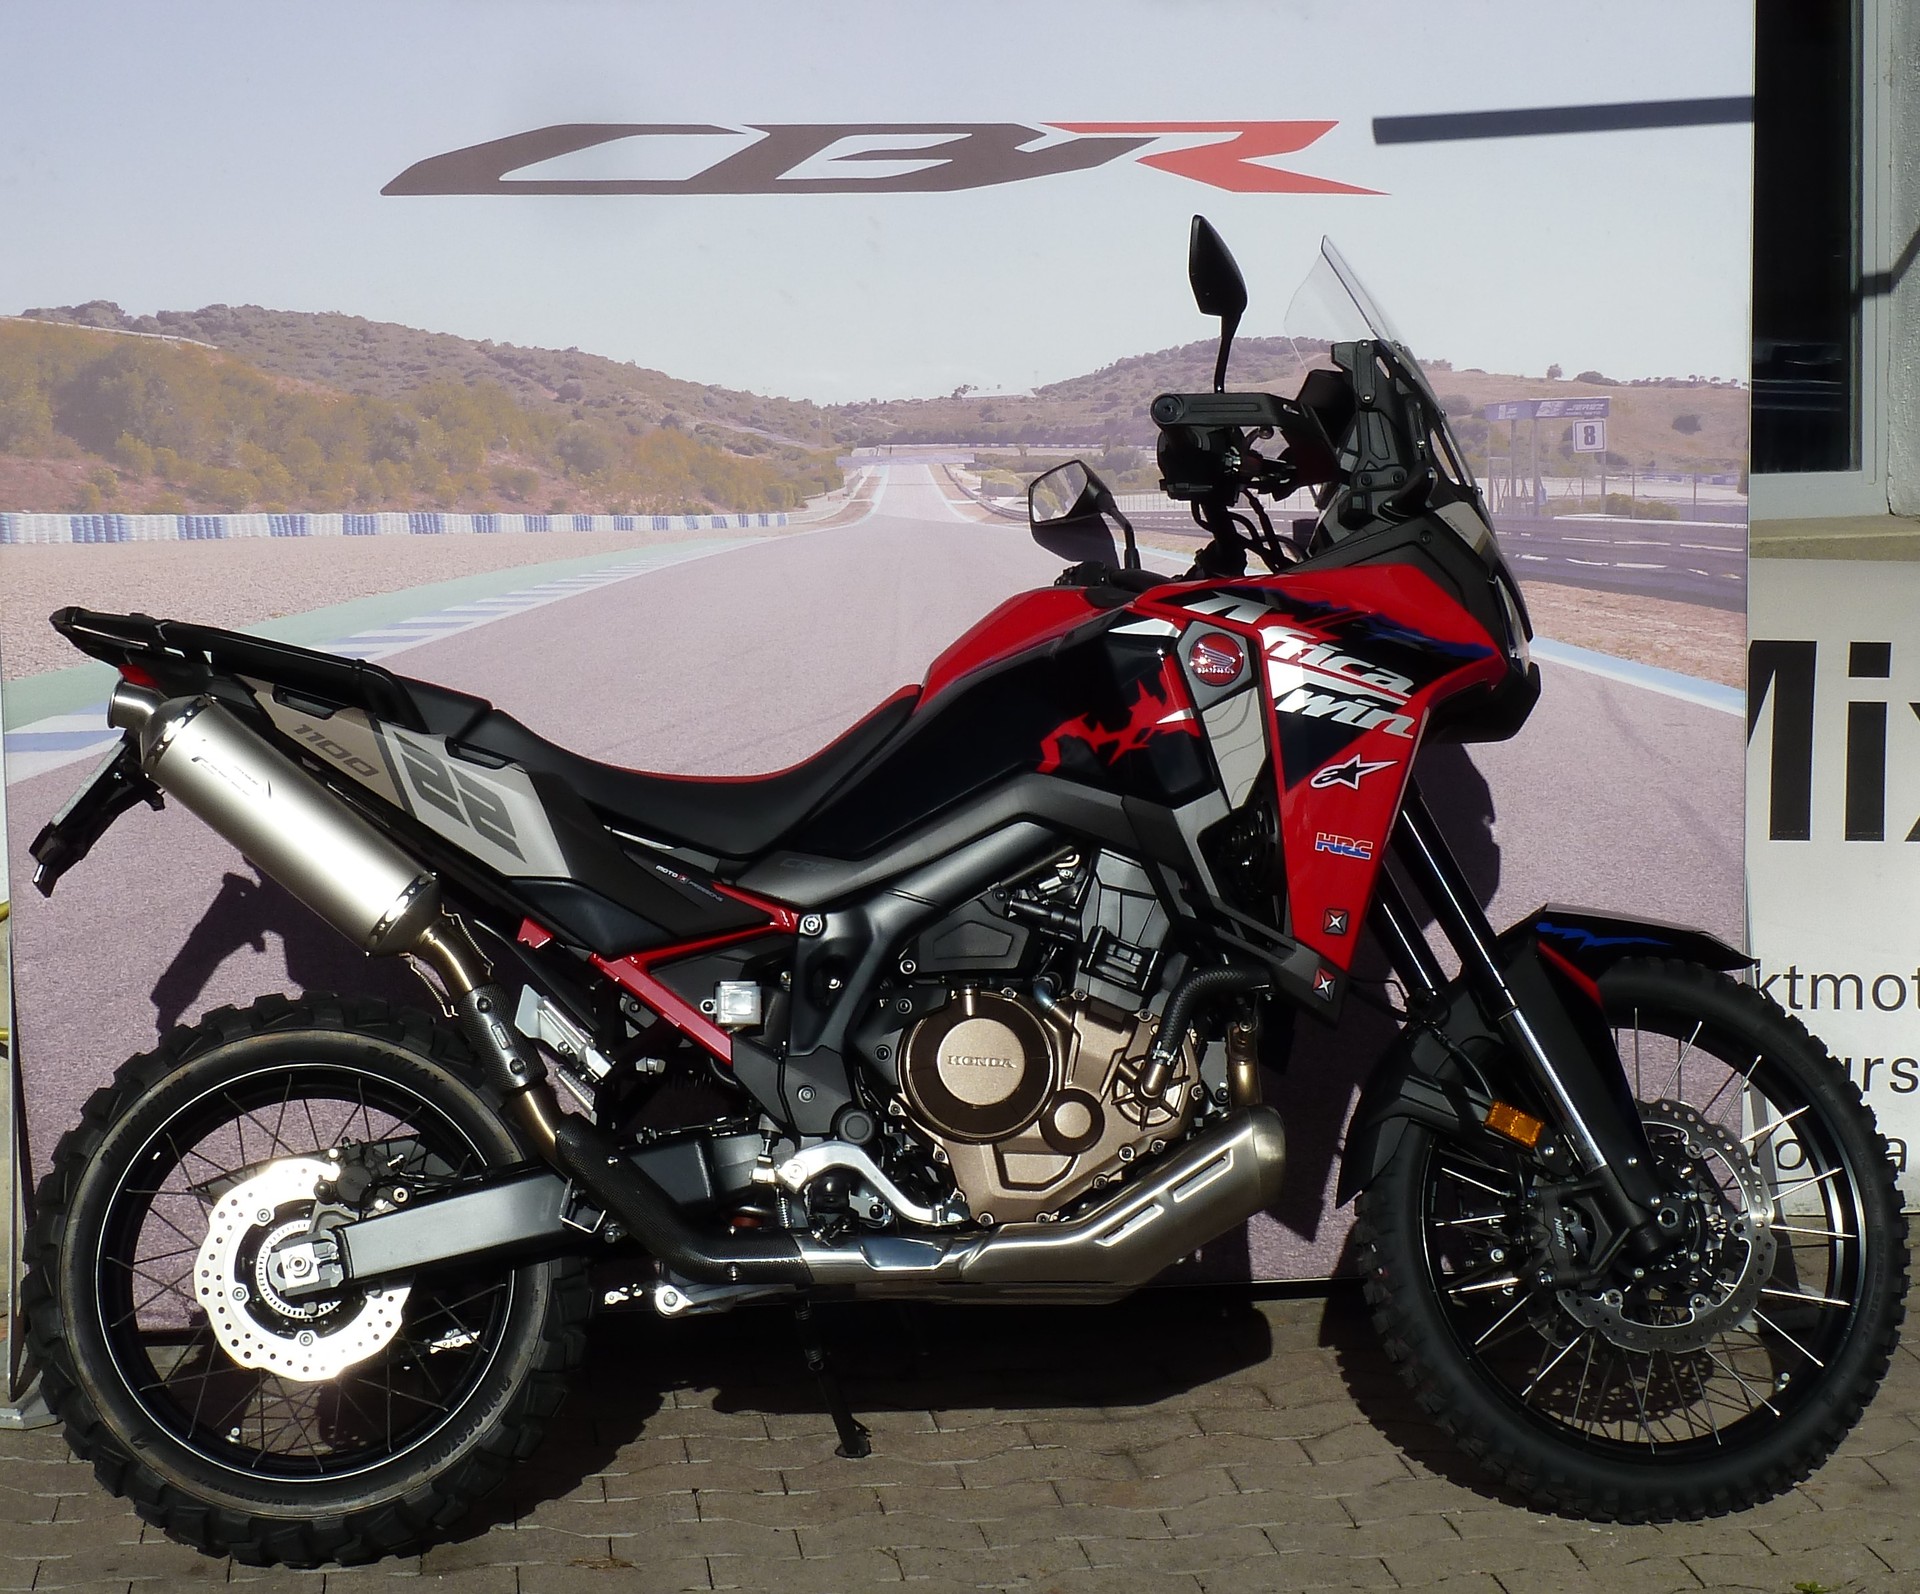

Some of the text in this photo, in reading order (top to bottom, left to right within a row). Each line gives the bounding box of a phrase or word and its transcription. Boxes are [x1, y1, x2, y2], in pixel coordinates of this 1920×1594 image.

[382, 121, 1391, 194] CBR
[1584, 425, 1596, 446] 8
[293, 723, 380, 778] 1100
[1315, 832, 1374, 860] HRC
[655, 864, 679, 879] MOTO
[948, 1055, 1017, 1069] HONDA
